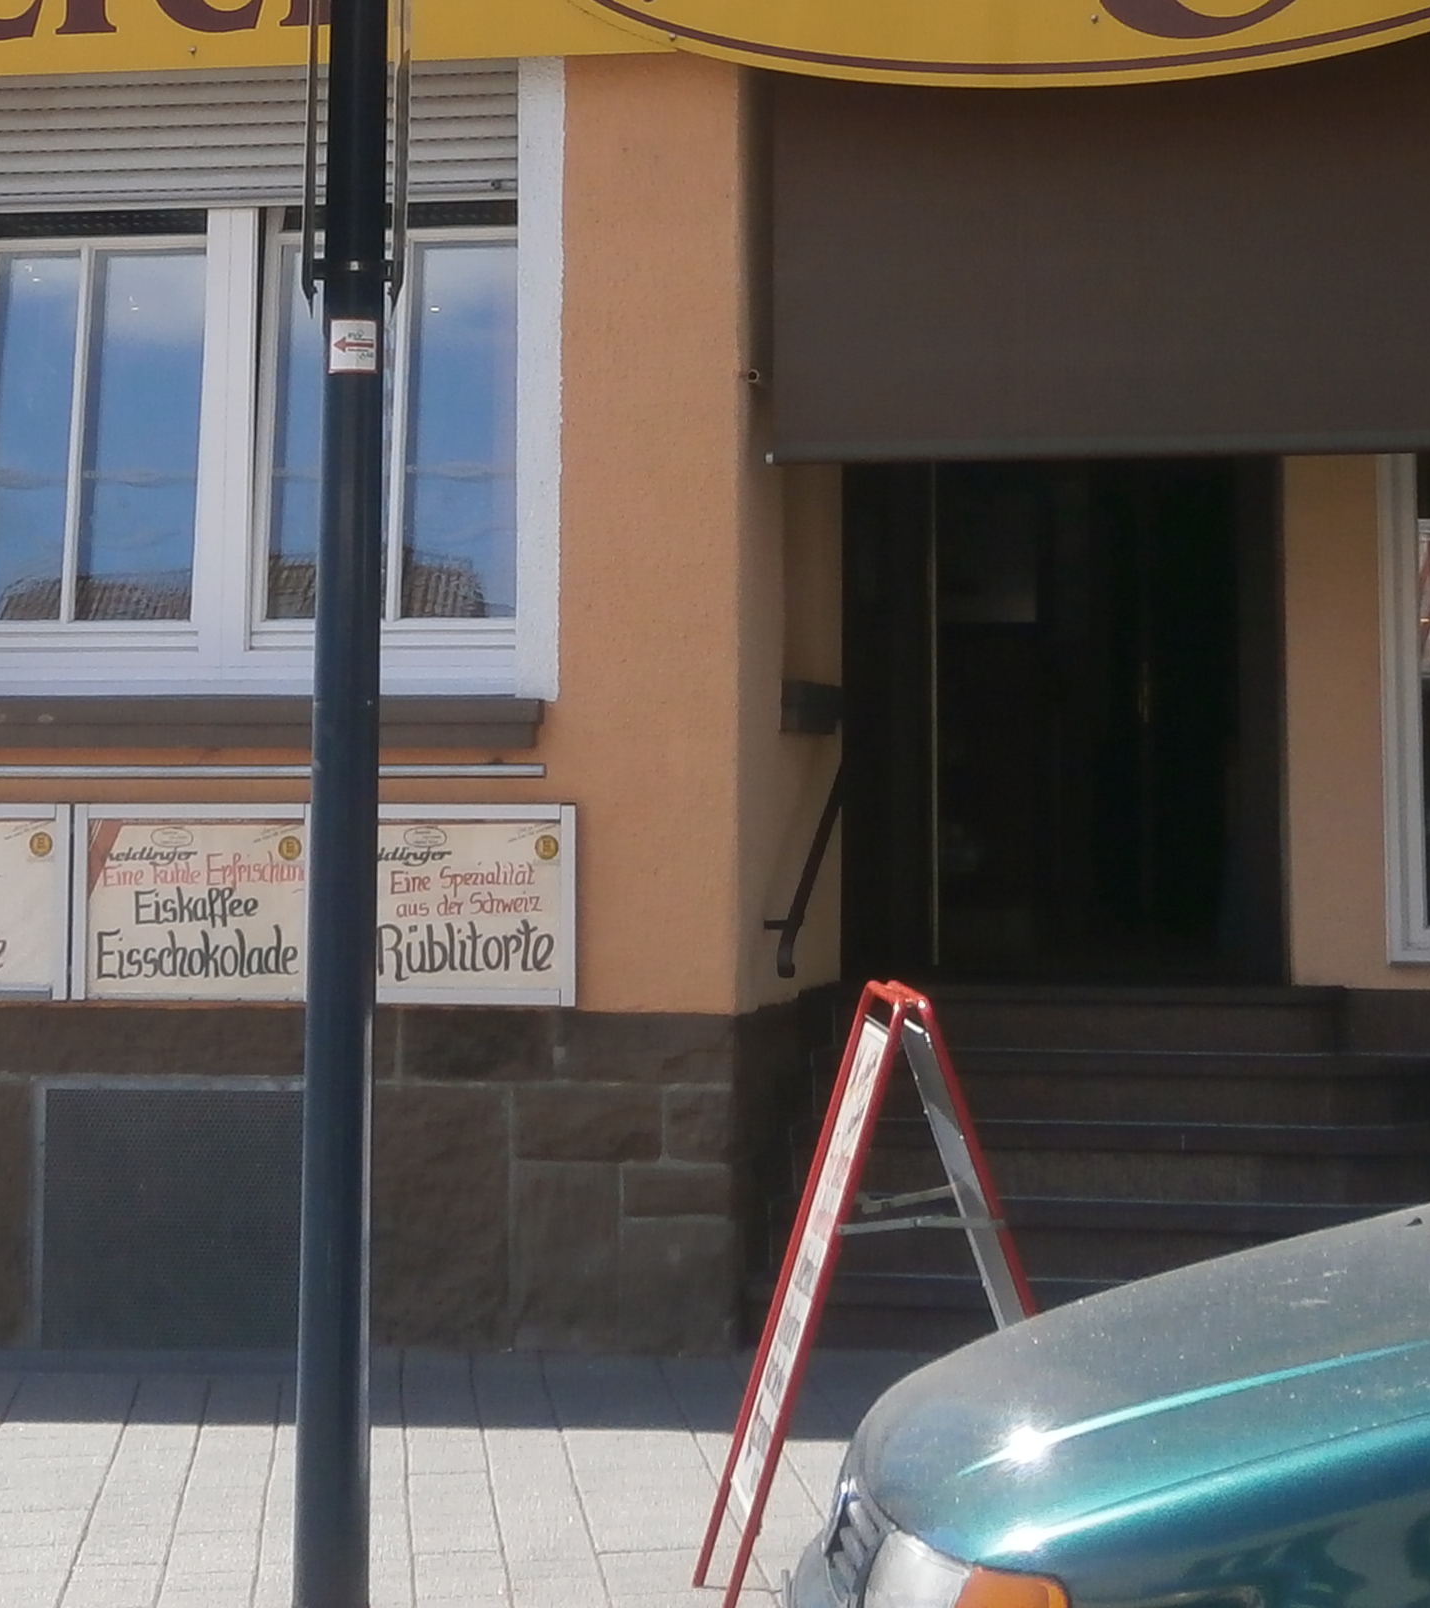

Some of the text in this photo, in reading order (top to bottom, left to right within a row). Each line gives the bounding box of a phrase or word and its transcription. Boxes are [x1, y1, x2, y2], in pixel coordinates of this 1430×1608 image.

[390, 861, 536, 897] Eine Spezialität
[134, 886, 259, 929] Eiskaffee
[396, 891, 543, 918] aus der Schweiz
[96, 924, 300, 980] Eisschokolade
[377, 918, 555, 982] Rüblitorte
